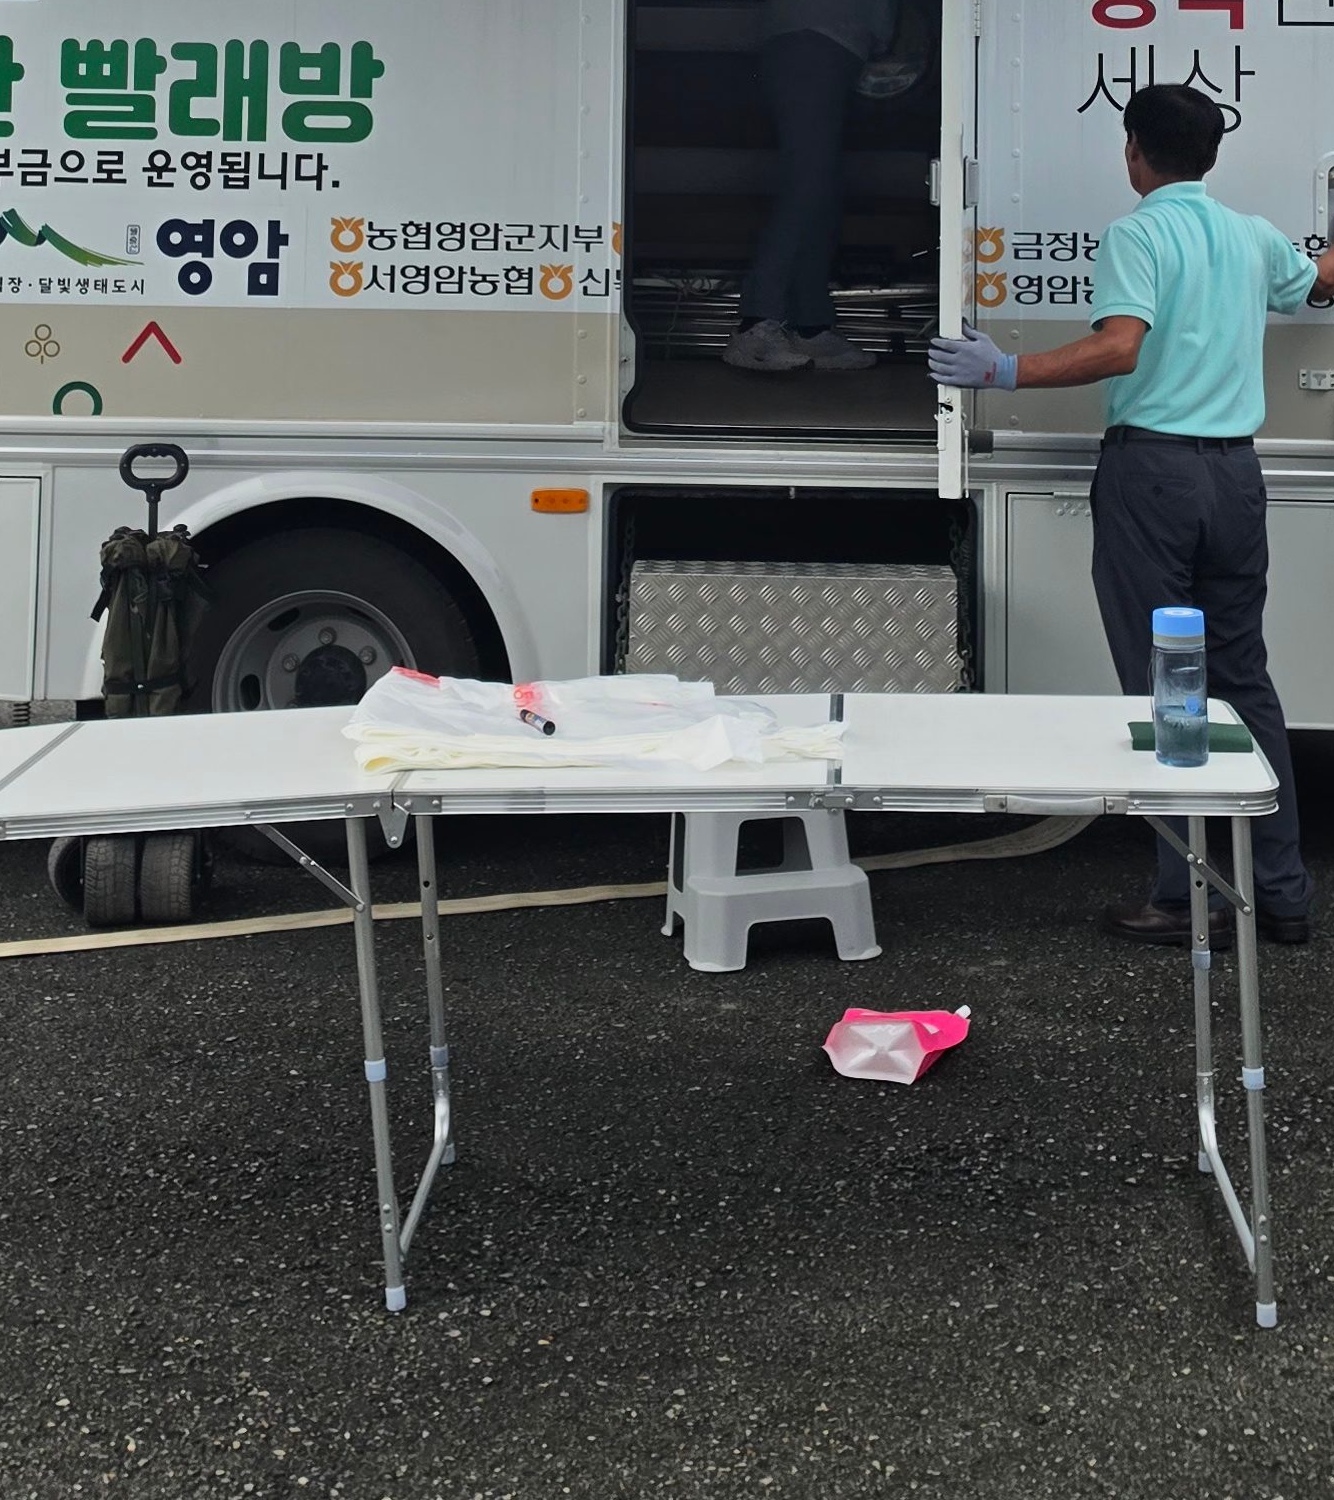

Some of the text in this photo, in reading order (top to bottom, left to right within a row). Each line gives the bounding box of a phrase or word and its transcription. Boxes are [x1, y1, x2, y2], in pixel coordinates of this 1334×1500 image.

[60, 37, 385, 143] 빨래방
[1076, 44, 1256, 134] 세상
[142, 148, 341, 192] 운영됩니다.
[156, 218, 289, 297] 영암
[365, 221, 604, 254] 농협영암군지부
[363, 264, 534, 297] 서영암농협
